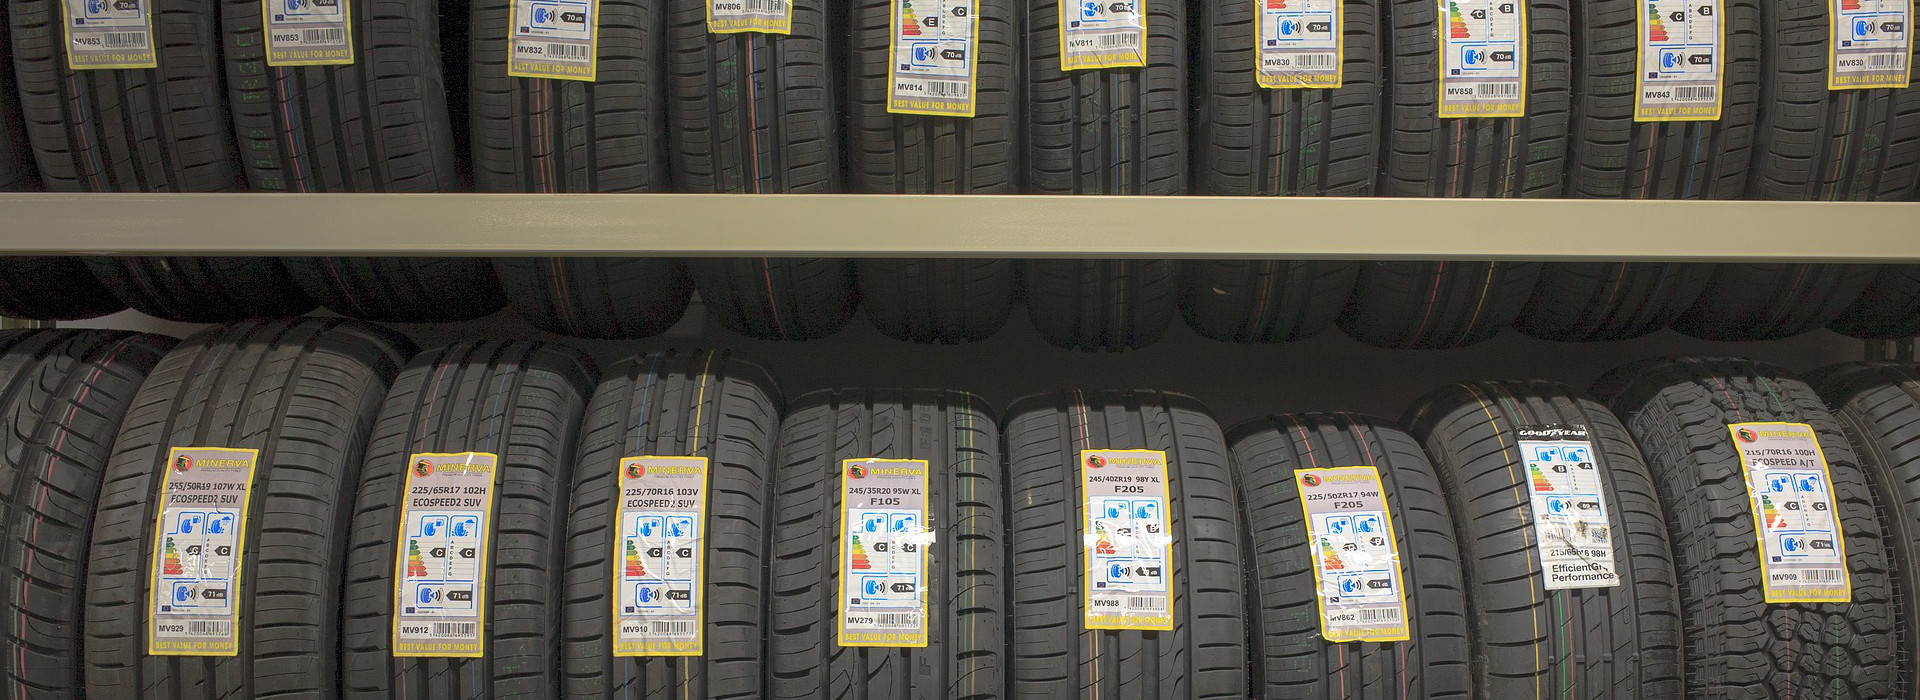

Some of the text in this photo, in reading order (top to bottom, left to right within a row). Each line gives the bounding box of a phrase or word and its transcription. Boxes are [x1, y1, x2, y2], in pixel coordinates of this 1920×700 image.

[730, 19, 748, 27] VALUE
[750, 18, 762, 26] FOR
[517, 46, 542, 54] MV832
[530, 63, 550, 71] VALUE
[567, 66, 591, 74] MONEY
[1835, 76, 1850, 84] BEST
[897, 83, 923, 91] MV814
[910, 101, 929, 109] VALUE
[946, 102, 969, 111] MONEY
[1444, 104, 1459, 112] BEST
[1461, 104, 1480, 112] VALUE
[1657, 107, 1676, 115] VALUE
[195, 459, 249, 468] MINERVA
[1800, 460, 1814, 468] A/T
[647, 466, 702, 474] MINERVA
[870, 468, 923, 476] MINERVA
[169, 482, 210, 490] 255/50R19
[412, 487, 460, 495] 225/65R17
[171, 495, 238, 503] ECOSPEED2 SUV
[1307, 492, 1358, 500] 225/50ZR17
[413, 498, 481, 507] ECOSPEED2 SUV
[627, 500, 695, 508] ECOSPEED2 SUV
[1334, 501, 1363, 509] F205
[1552, 573, 1614, 582] Performance
